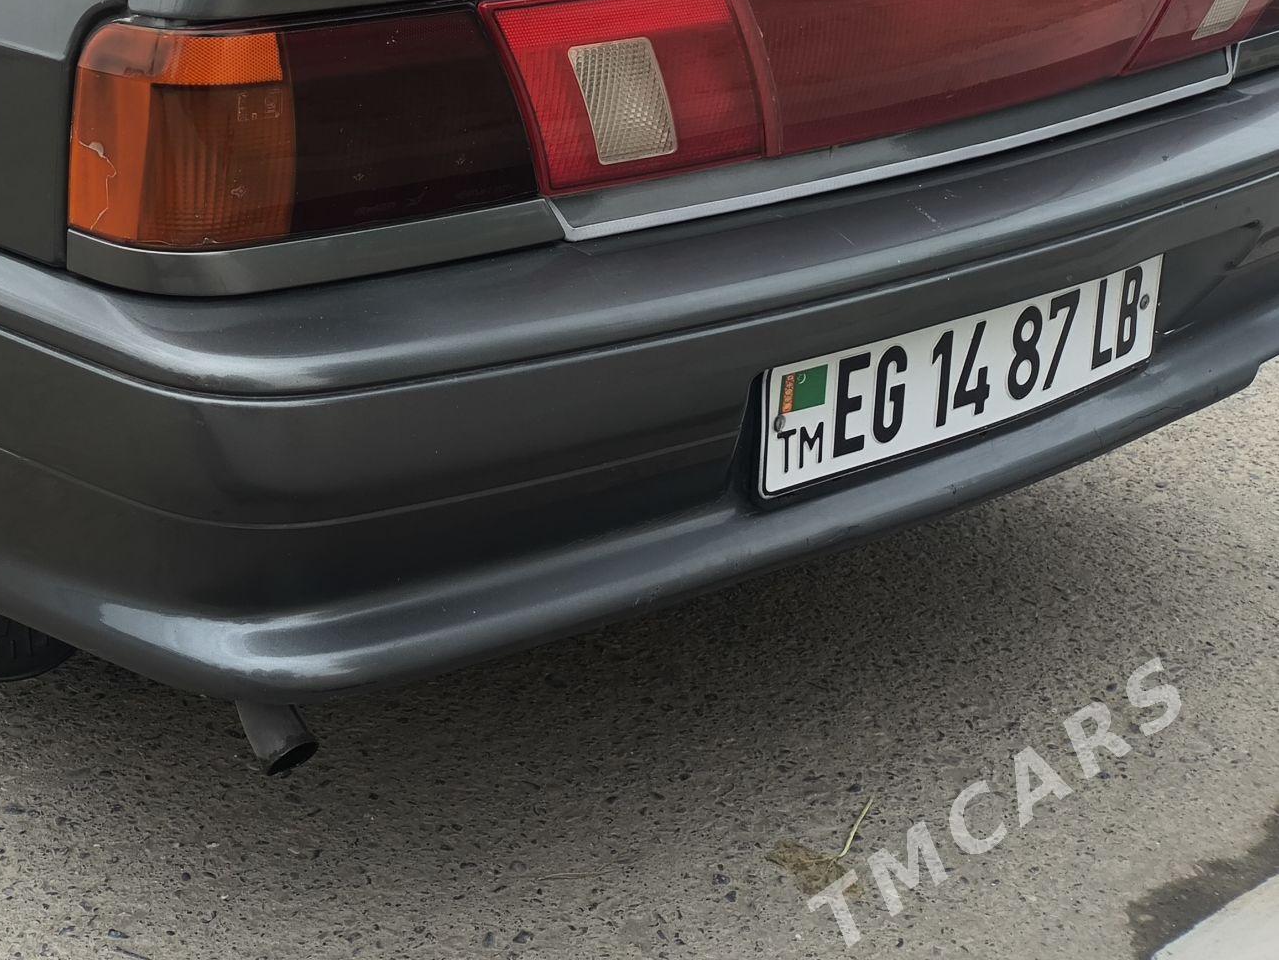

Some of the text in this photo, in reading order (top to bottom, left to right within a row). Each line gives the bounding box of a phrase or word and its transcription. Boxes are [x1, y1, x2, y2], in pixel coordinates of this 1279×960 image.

[832, 345, 908, 458] EG
[1090, 266, 1144, 370] LB
[776, 421, 825, 473] TM
